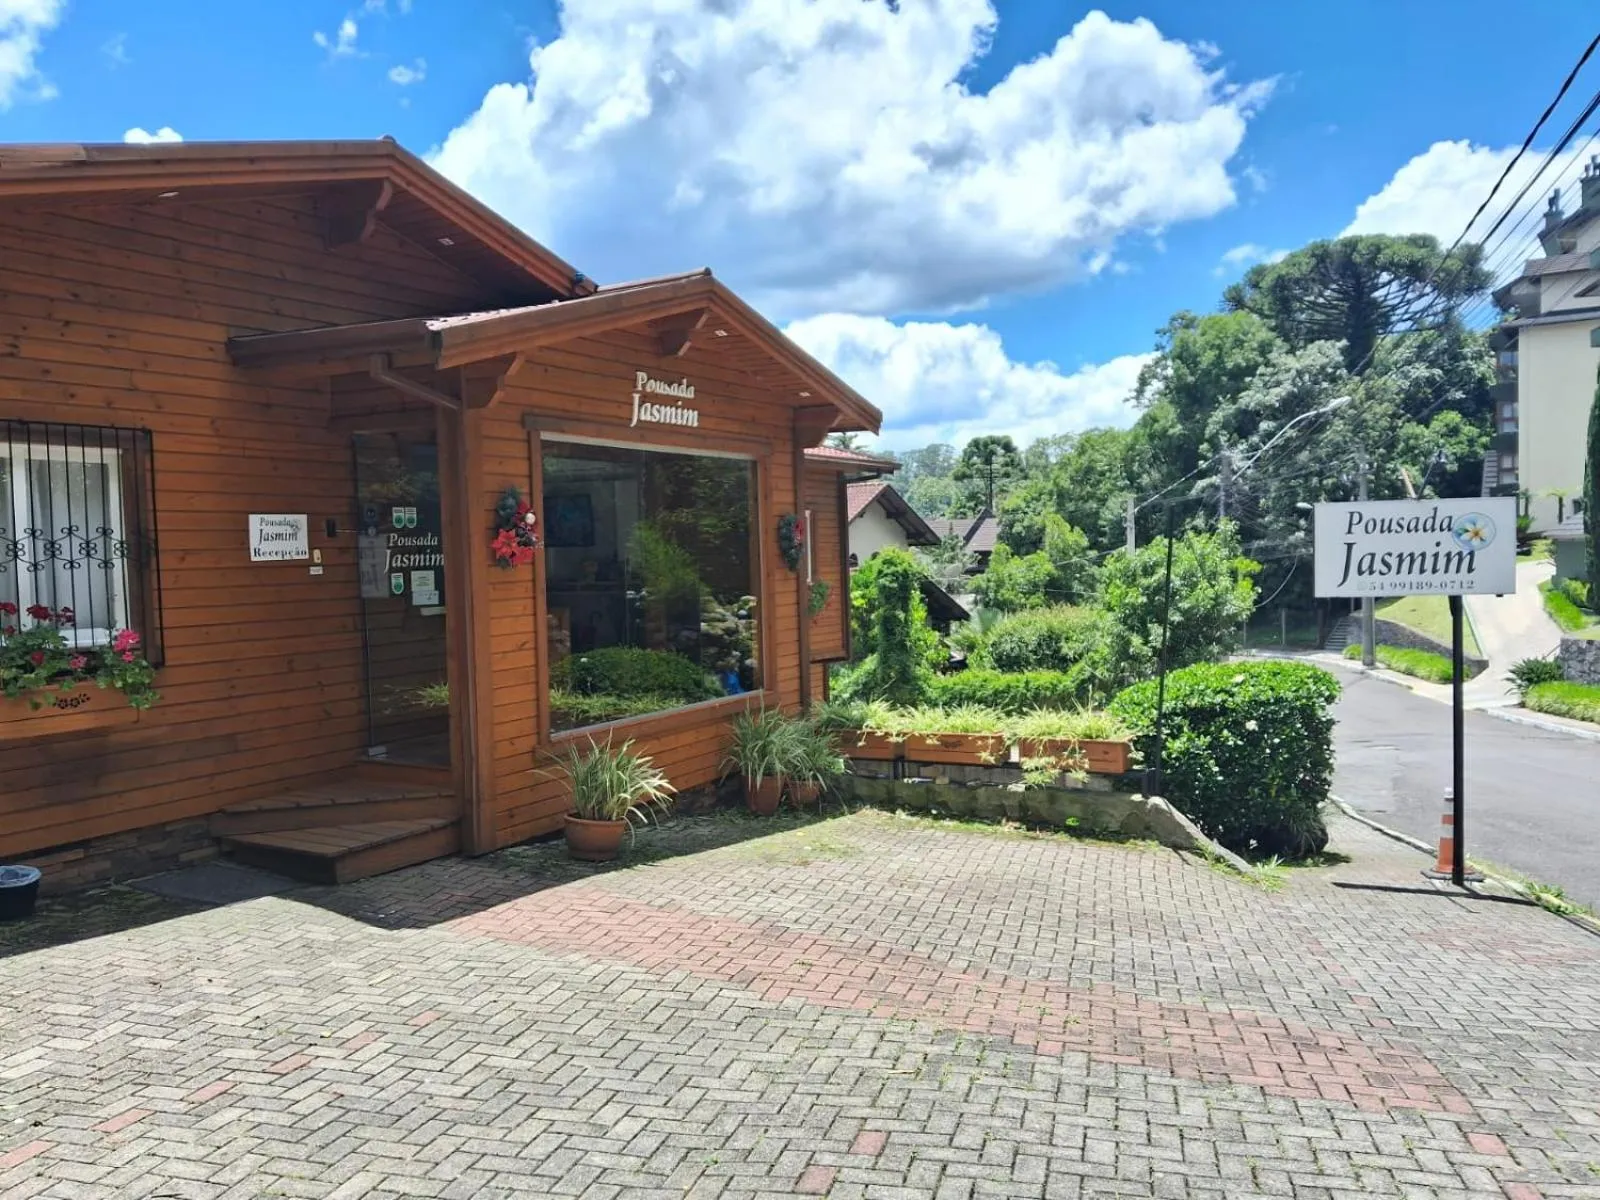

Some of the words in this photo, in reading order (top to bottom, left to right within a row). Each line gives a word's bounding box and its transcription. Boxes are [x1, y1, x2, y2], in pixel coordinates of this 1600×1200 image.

[636, 371, 695, 399] Pousada
[630, 393, 699, 428] Jasmim
[260, 516, 291, 526] Pousada
[1345, 507, 1453, 535] Pousada
[259, 528, 298, 544] Jasmim
[388, 532, 438, 546] Pousada
[253, 547, 307, 559] Recepção
[383, 549, 445, 573] Jasmim
[1337, 541, 1476, 588] Jasmim
